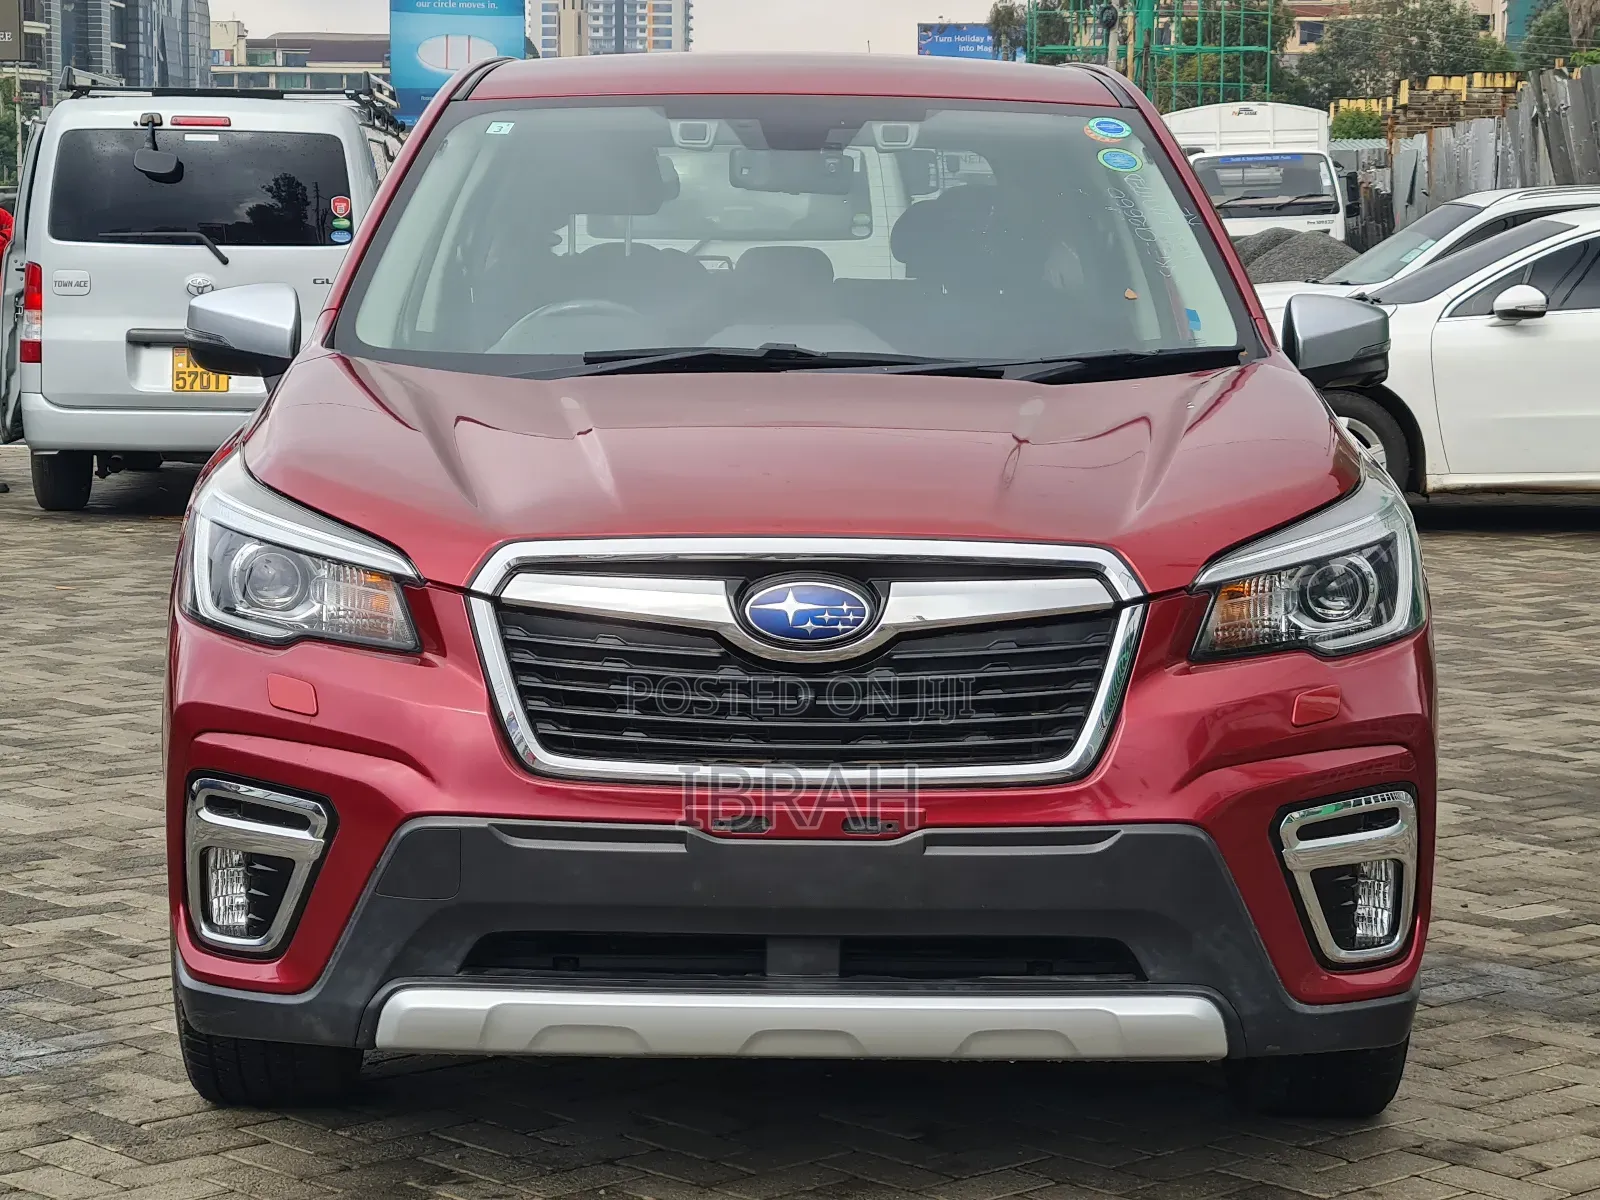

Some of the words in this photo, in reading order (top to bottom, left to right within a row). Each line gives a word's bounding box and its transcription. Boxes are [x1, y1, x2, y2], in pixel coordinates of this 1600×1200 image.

[416, 0, 430, 8] our
[433, 0, 457, 8] circle
[459, 1, 485, 9] moves
[954, 35, 985, 44] Holiday
[54, 280, 73, 288] TOWN
[74, 280, 89, 288] ACE
